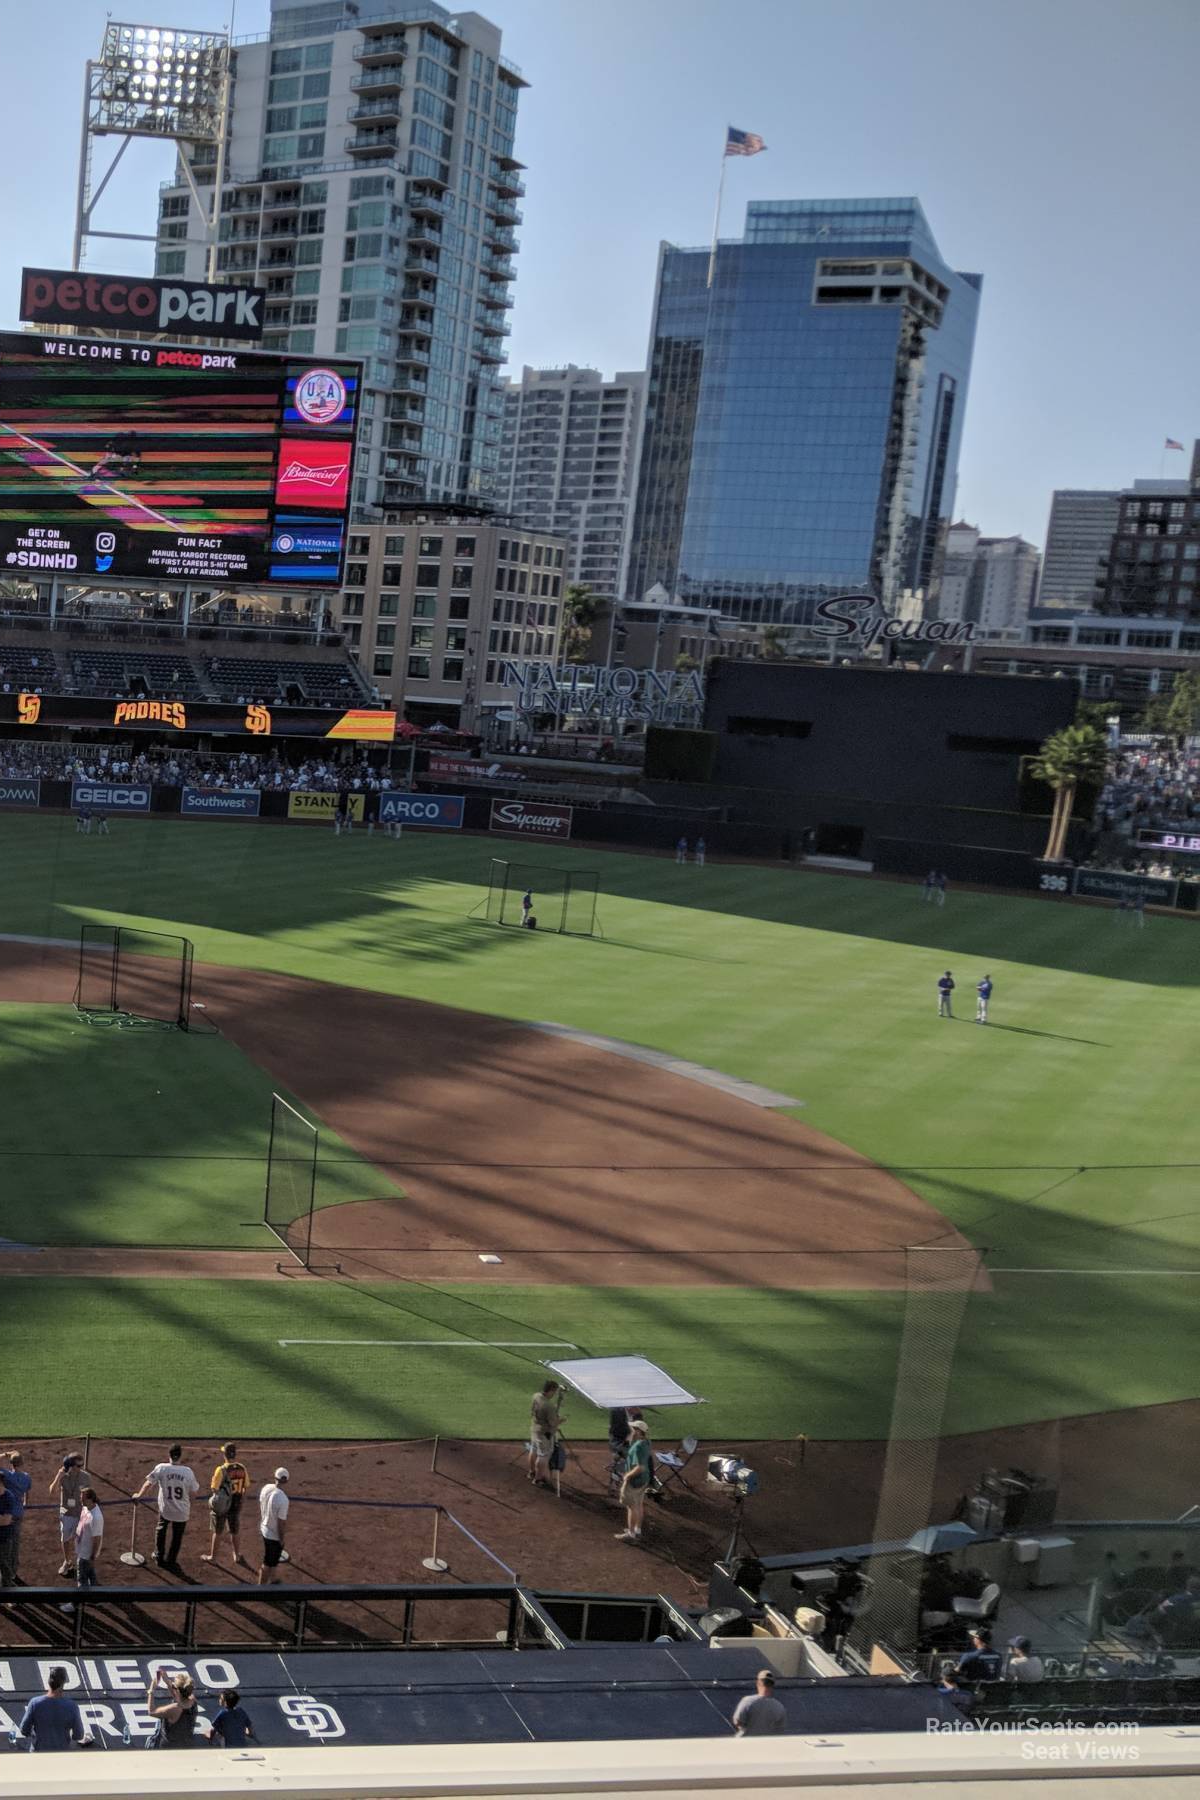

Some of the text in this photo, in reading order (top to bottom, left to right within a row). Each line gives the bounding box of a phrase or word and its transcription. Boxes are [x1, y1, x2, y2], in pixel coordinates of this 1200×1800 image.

[26, 276, 261, 328] petcopark
[44, 342, 236, 368] WELCOME TO petcopark
[288, 466, 338, 480] Budweiser
[28, 528, 60, 539] GET ON
[16, 537, 71, 550] THE SCREEN
[178, 538, 222, 548] FUN FACT
[296, 538, 337, 548] NATIONAL
[152, 549, 179, 558] MANUEL
[210, 553, 246, 562] RECORDED
[148, 557, 160, 565] HIS
[161, 558, 181, 566] FIRST
[182, 559, 209, 568] CAREER
[229, 562, 248, 570] GAME
[166, 566, 182, 574] JULY
[199, 569, 229, 577] ARIZONA
[811, 593, 976, 650] Sycuan
[502, 661, 705, 700] NATIONA
[114, 700, 186, 729] PADRES
[75, 788, 148, 805] GEICO
[187, 794, 247, 809] Southwest
[294, 795, 359, 809] STANLY
[383, 801, 440, 818] ARCO
[496, 803, 563, 830] Sycuan
[167, 1486, 184, 1500] 19
[37, 1657, 241, 1691] DIEGO
